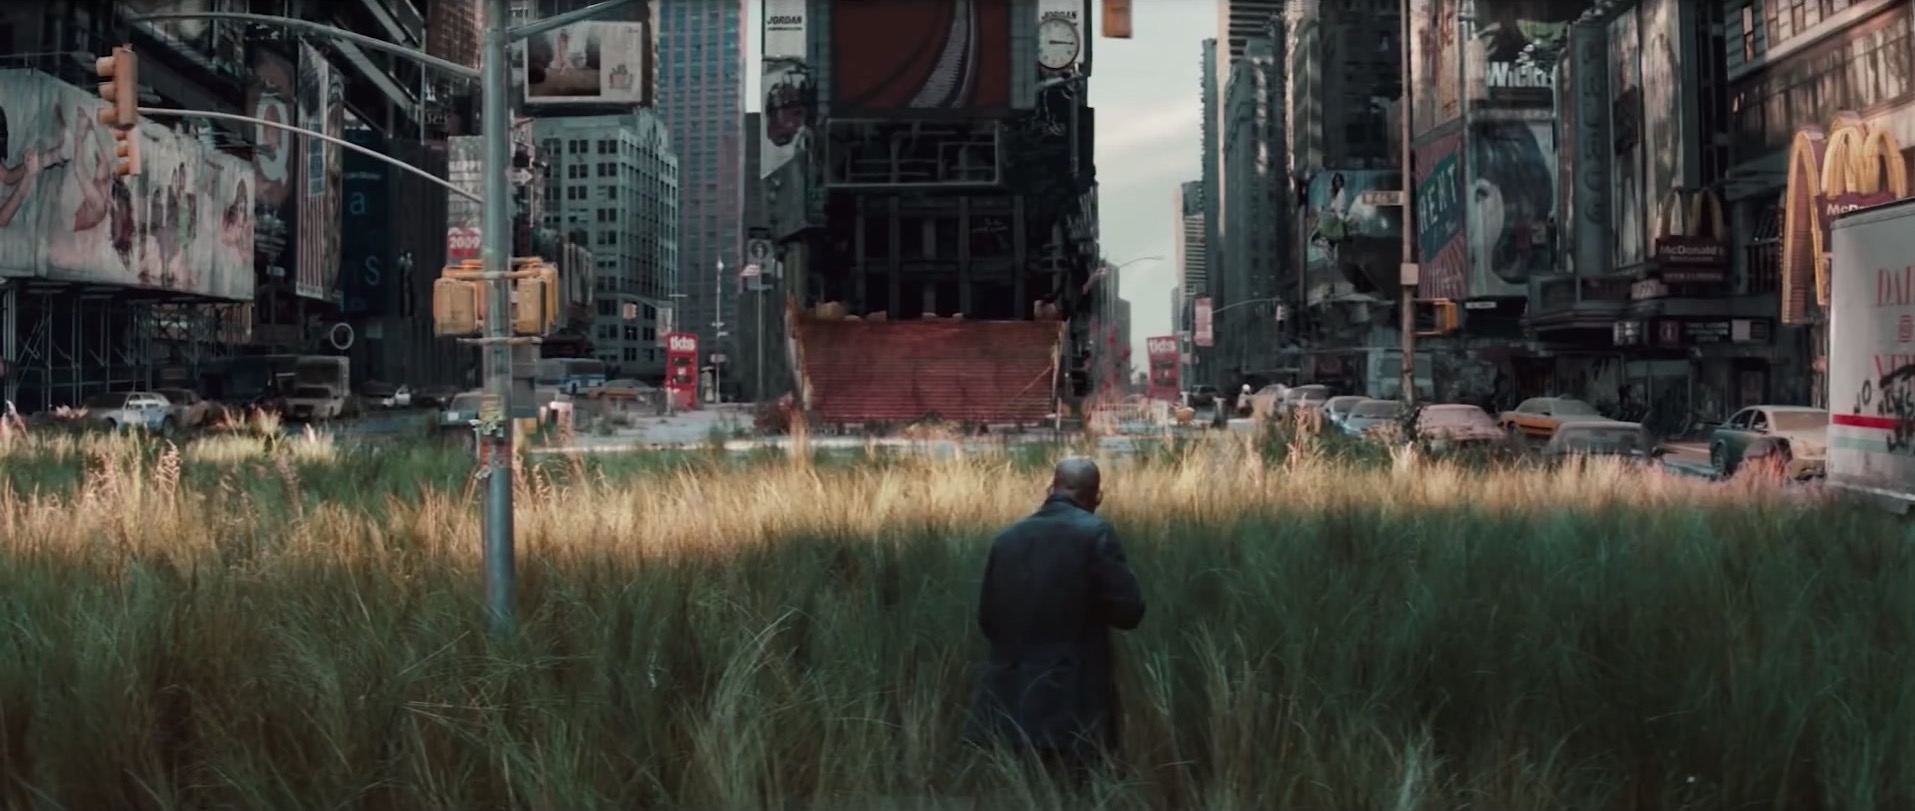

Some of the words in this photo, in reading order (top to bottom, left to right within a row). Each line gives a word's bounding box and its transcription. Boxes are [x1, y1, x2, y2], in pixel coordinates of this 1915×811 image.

[767, 16, 802, 25] JORDAN
[1419, 163, 1456, 234] RENT
[449, 236, 481, 249] 2009
